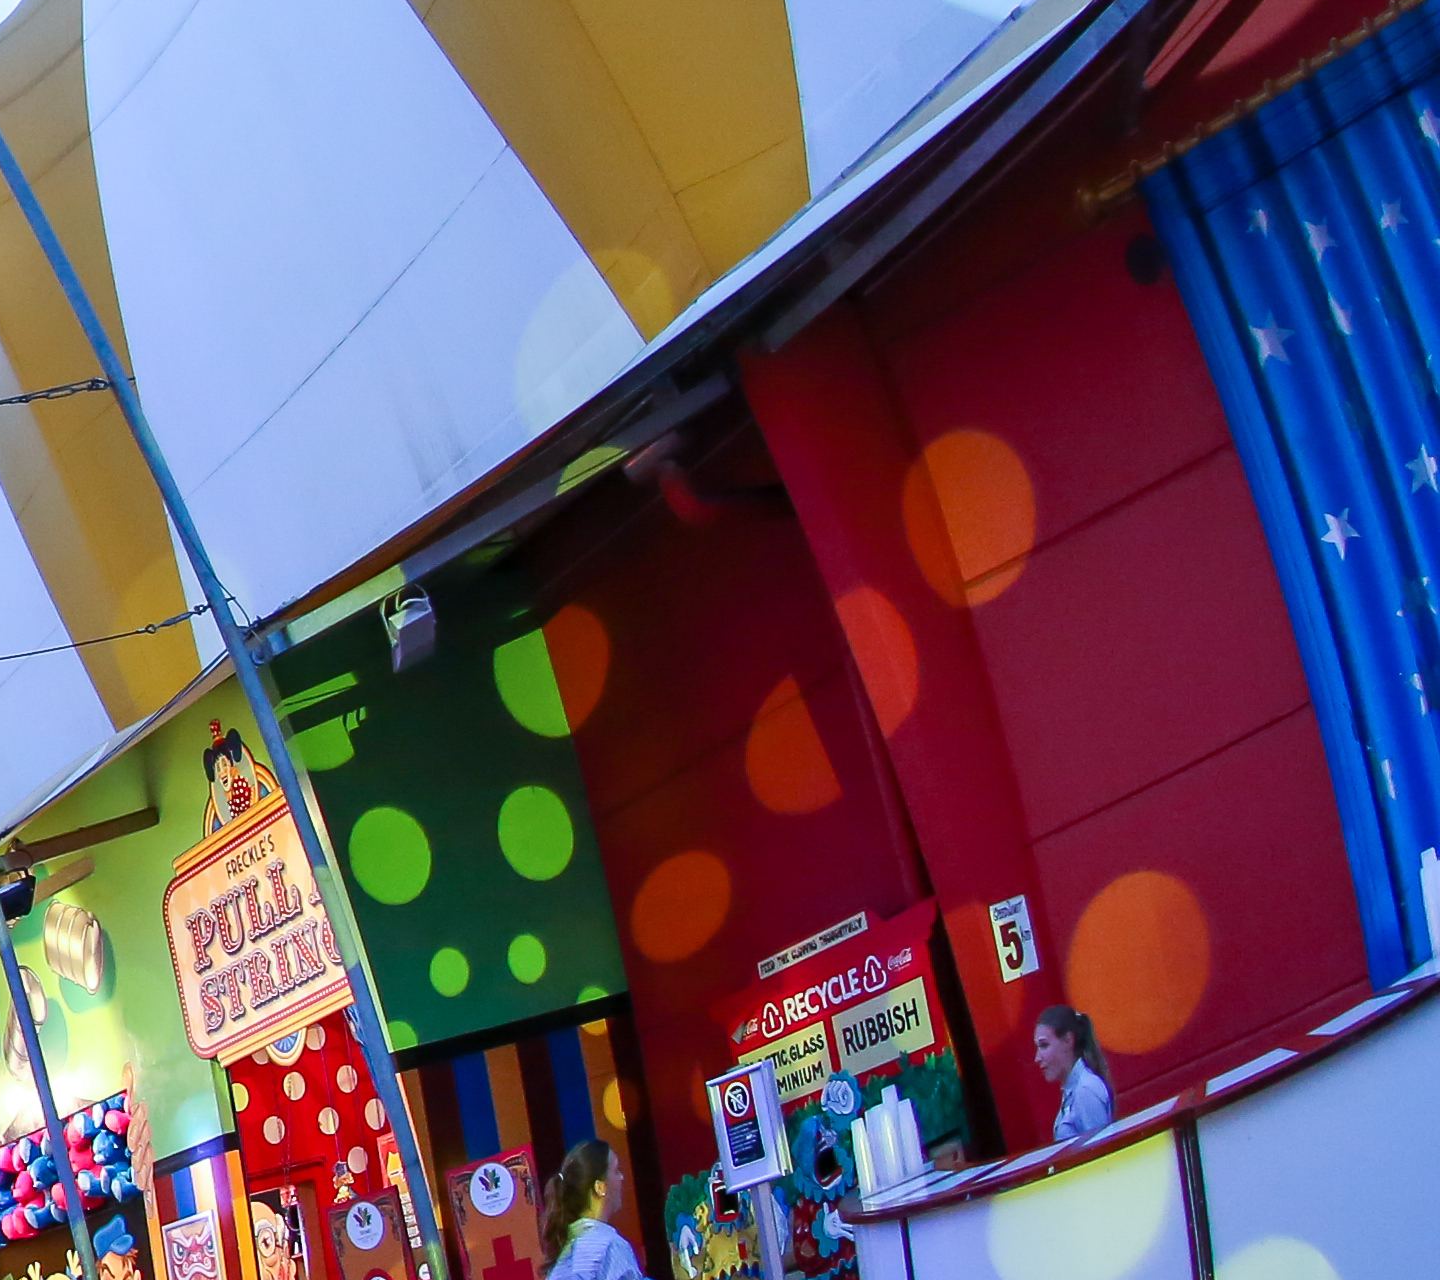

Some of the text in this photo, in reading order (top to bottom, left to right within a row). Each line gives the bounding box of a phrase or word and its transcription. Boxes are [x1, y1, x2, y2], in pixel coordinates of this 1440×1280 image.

[225, 833, 276, 880] FRECKLE'S
[186, 858, 302, 973] PULL
[999, 920, 1024, 970] 5
[782, 967, 862, 1026] RECYCLE
[841, 998, 921, 1057] RUBBISH
[776, 1060, 824, 1095] MINIUM
